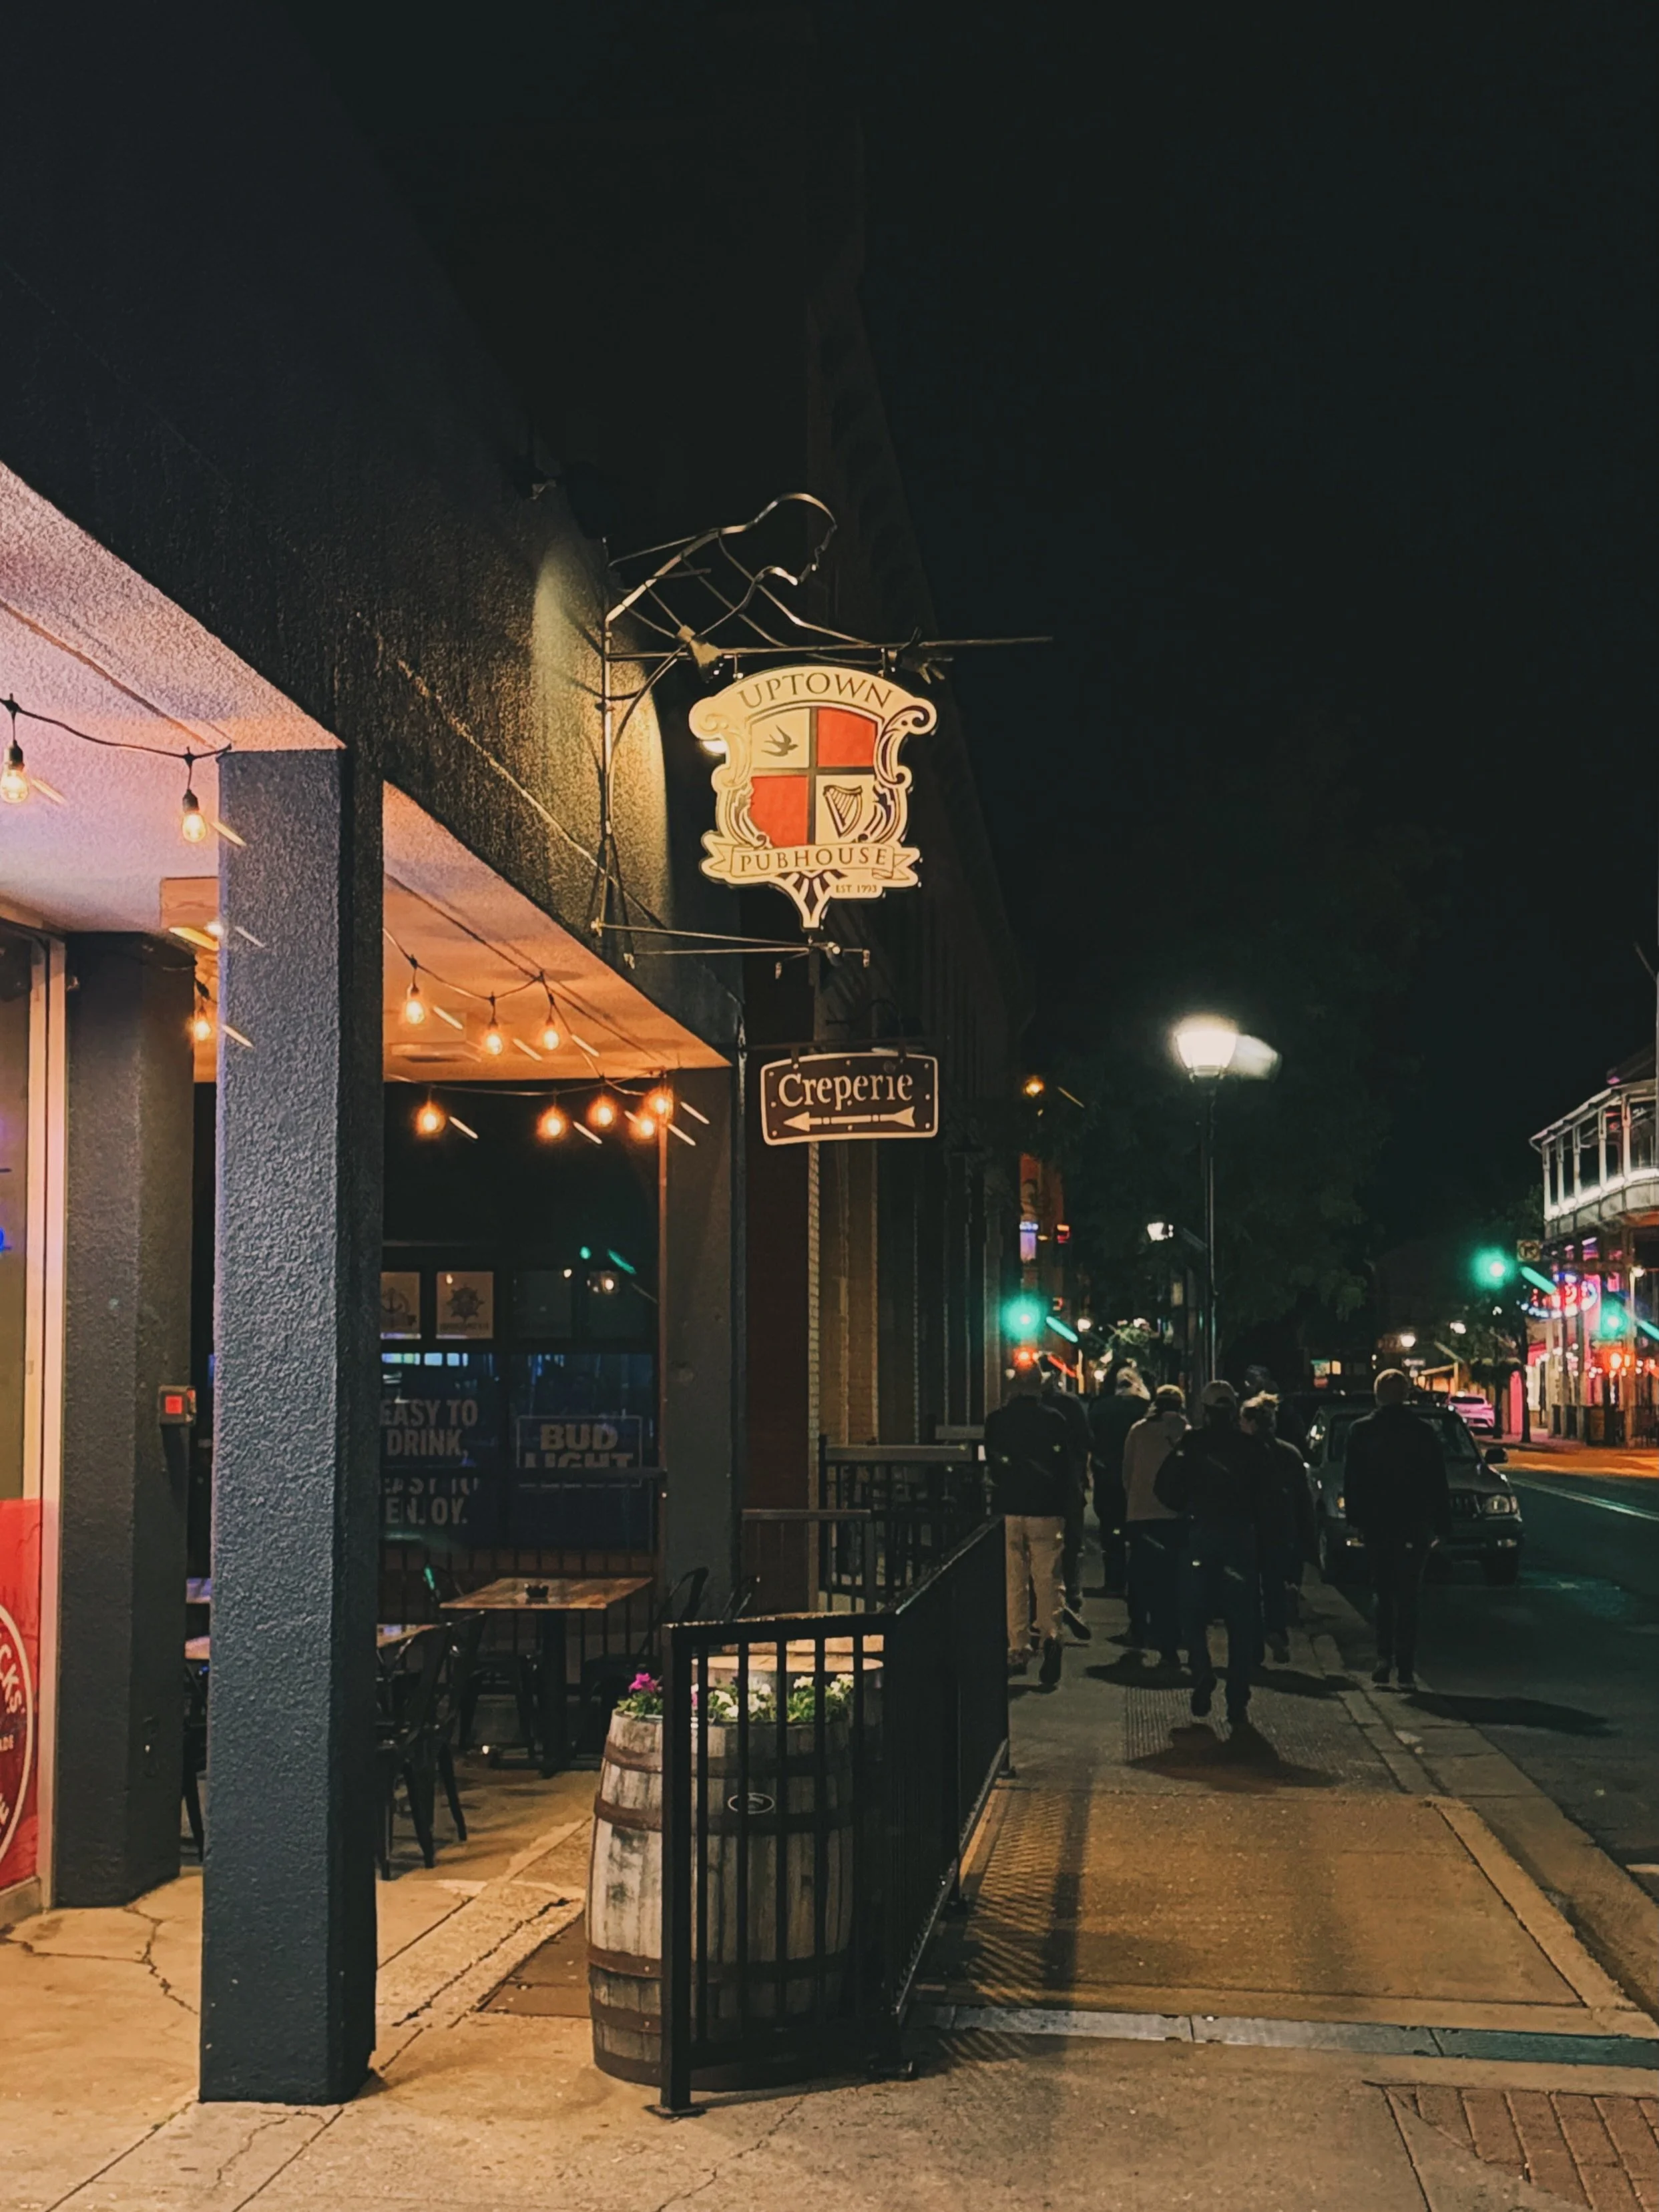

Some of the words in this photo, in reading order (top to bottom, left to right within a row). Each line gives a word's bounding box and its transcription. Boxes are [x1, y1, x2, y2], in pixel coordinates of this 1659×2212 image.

[737, 672, 894, 709] UPTOWN
[740, 846, 888, 872] PUBHOUSE
[836, 884, 853, 893] EST
[778, 1073, 913, 1111] Creperie
[380, 1399, 441, 1426] EASY
[446, 1399, 478, 1427] TO
[539, 1423, 618, 1451] BUD
